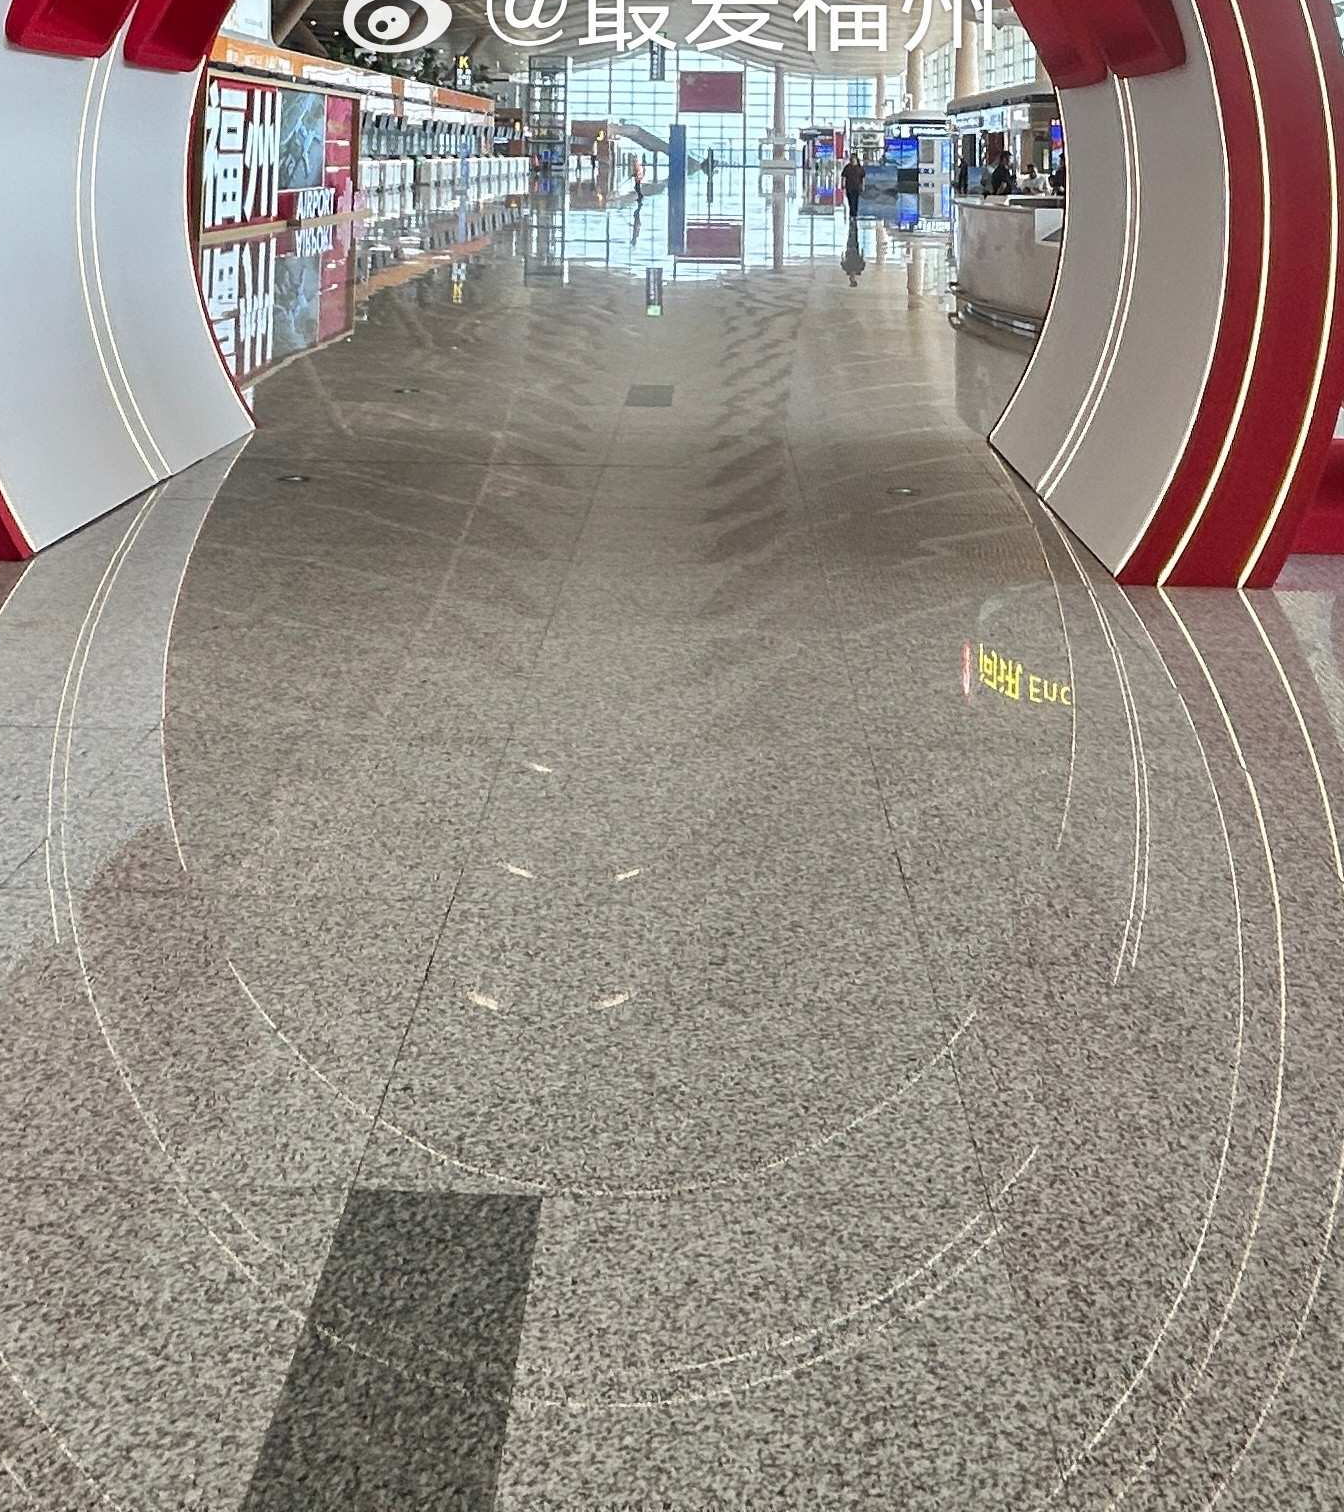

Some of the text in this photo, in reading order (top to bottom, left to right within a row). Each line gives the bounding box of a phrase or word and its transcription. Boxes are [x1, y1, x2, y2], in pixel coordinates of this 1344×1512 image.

[459, 56, 469, 68] K
[204, 79, 283, 229] 福州
[295, 188, 335, 221] AIRPORT
